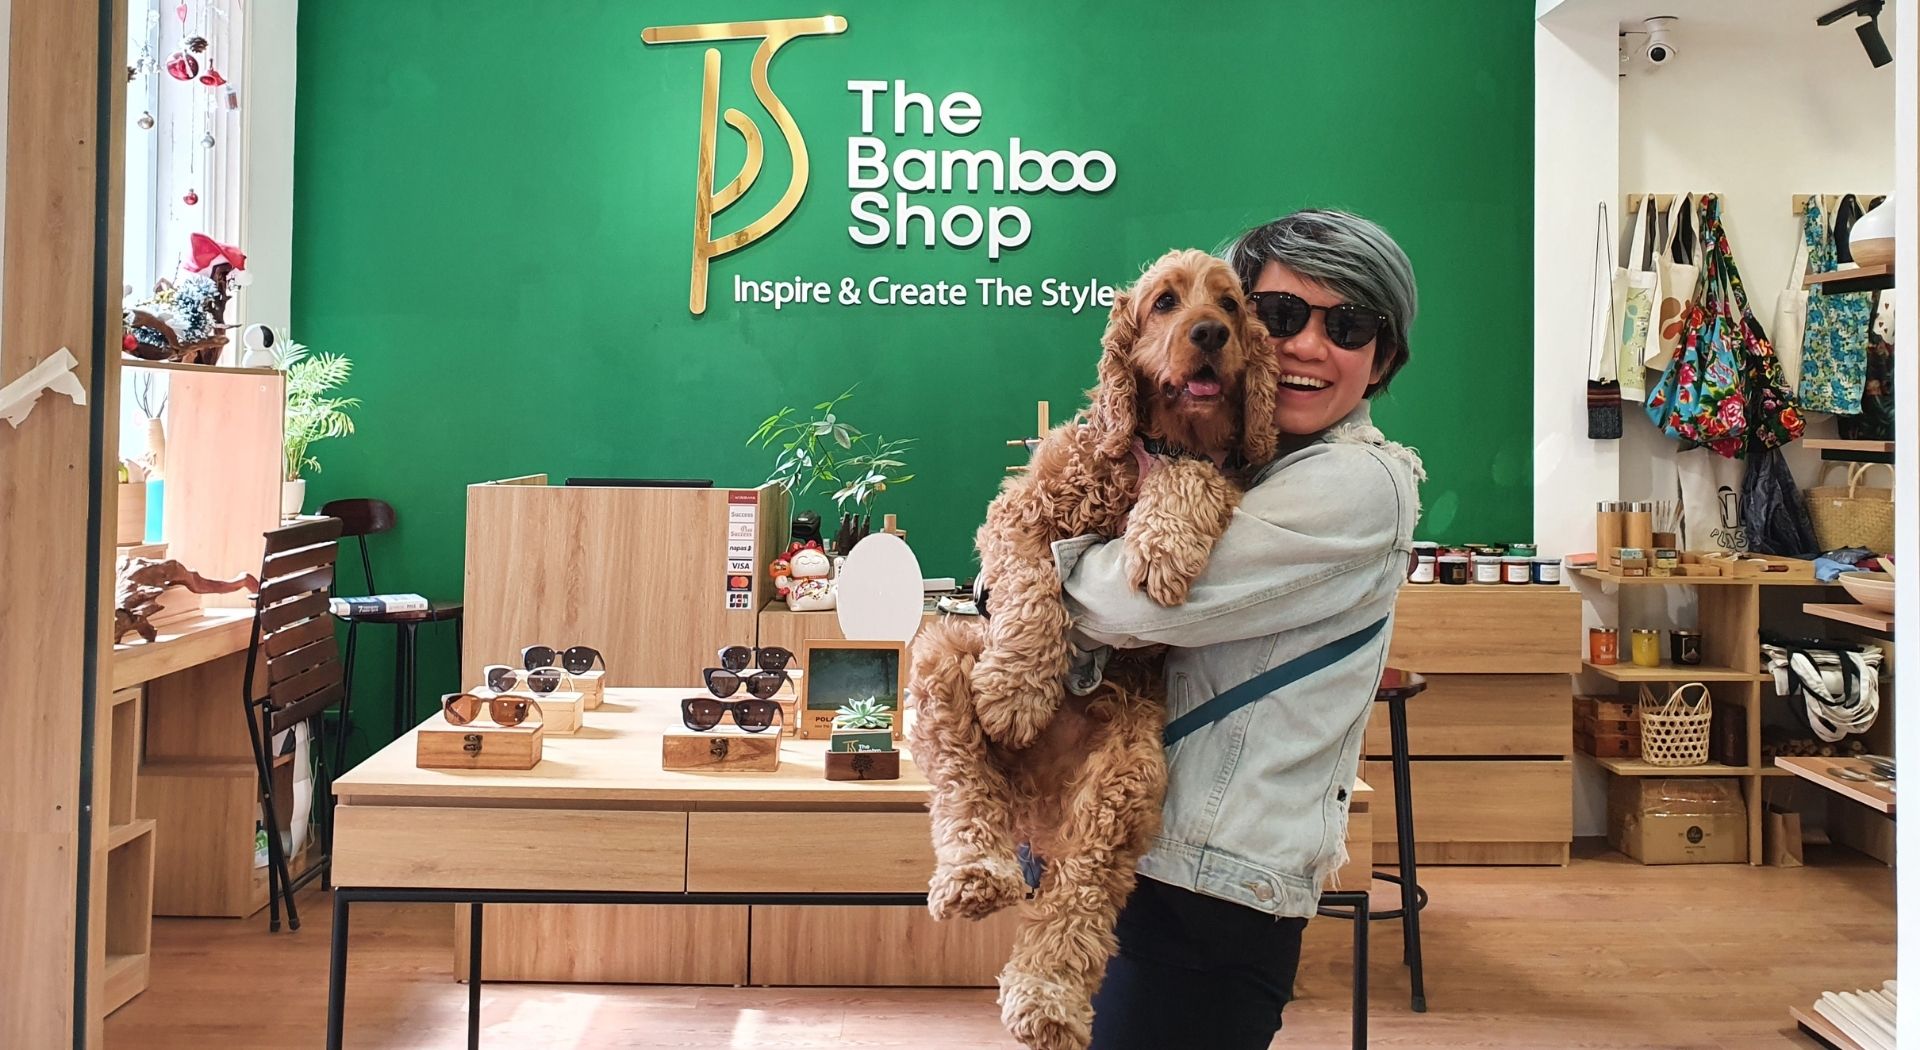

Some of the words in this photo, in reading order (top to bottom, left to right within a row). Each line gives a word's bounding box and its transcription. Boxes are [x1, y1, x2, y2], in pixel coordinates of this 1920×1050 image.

[847, 79, 982, 135] The
[847, 136, 1117, 192] Bamboo
[847, 191, 1032, 259] Shop
[734, 274, 831, 309] Inspire
[838, 277, 861, 305] &
[868, 276, 966, 305] Create
[976, 277, 1032, 306] The
[1042, 278, 1114, 314] Style
[732, 562, 750, 570] VISA
